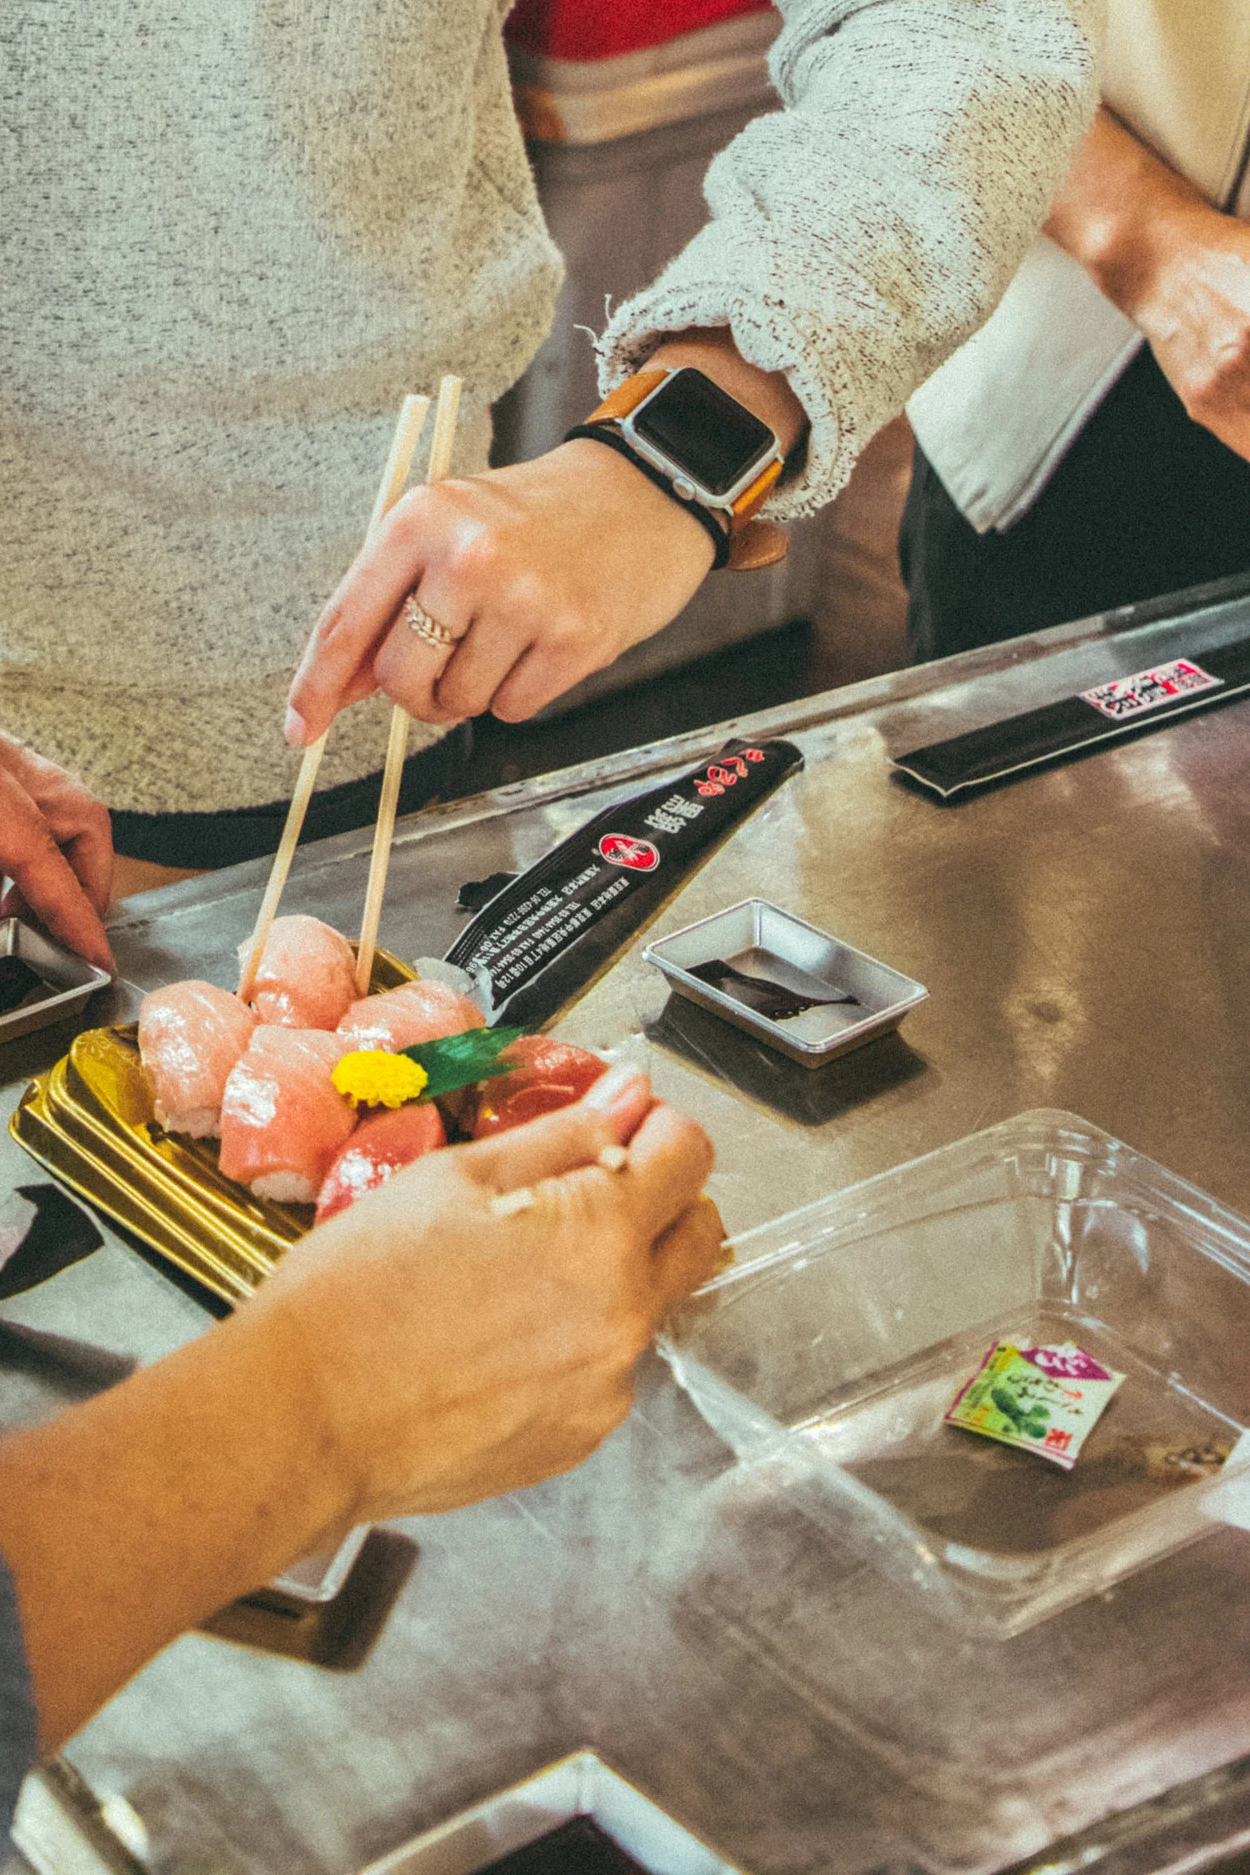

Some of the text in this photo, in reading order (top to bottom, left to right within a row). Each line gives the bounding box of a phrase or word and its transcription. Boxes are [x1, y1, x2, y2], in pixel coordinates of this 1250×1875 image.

[535, 885, 552, 898] TEL
[564, 899, 581, 912] TEL
[488, 924, 505, 941] FAX
[517, 936, 535, 950] FAX
